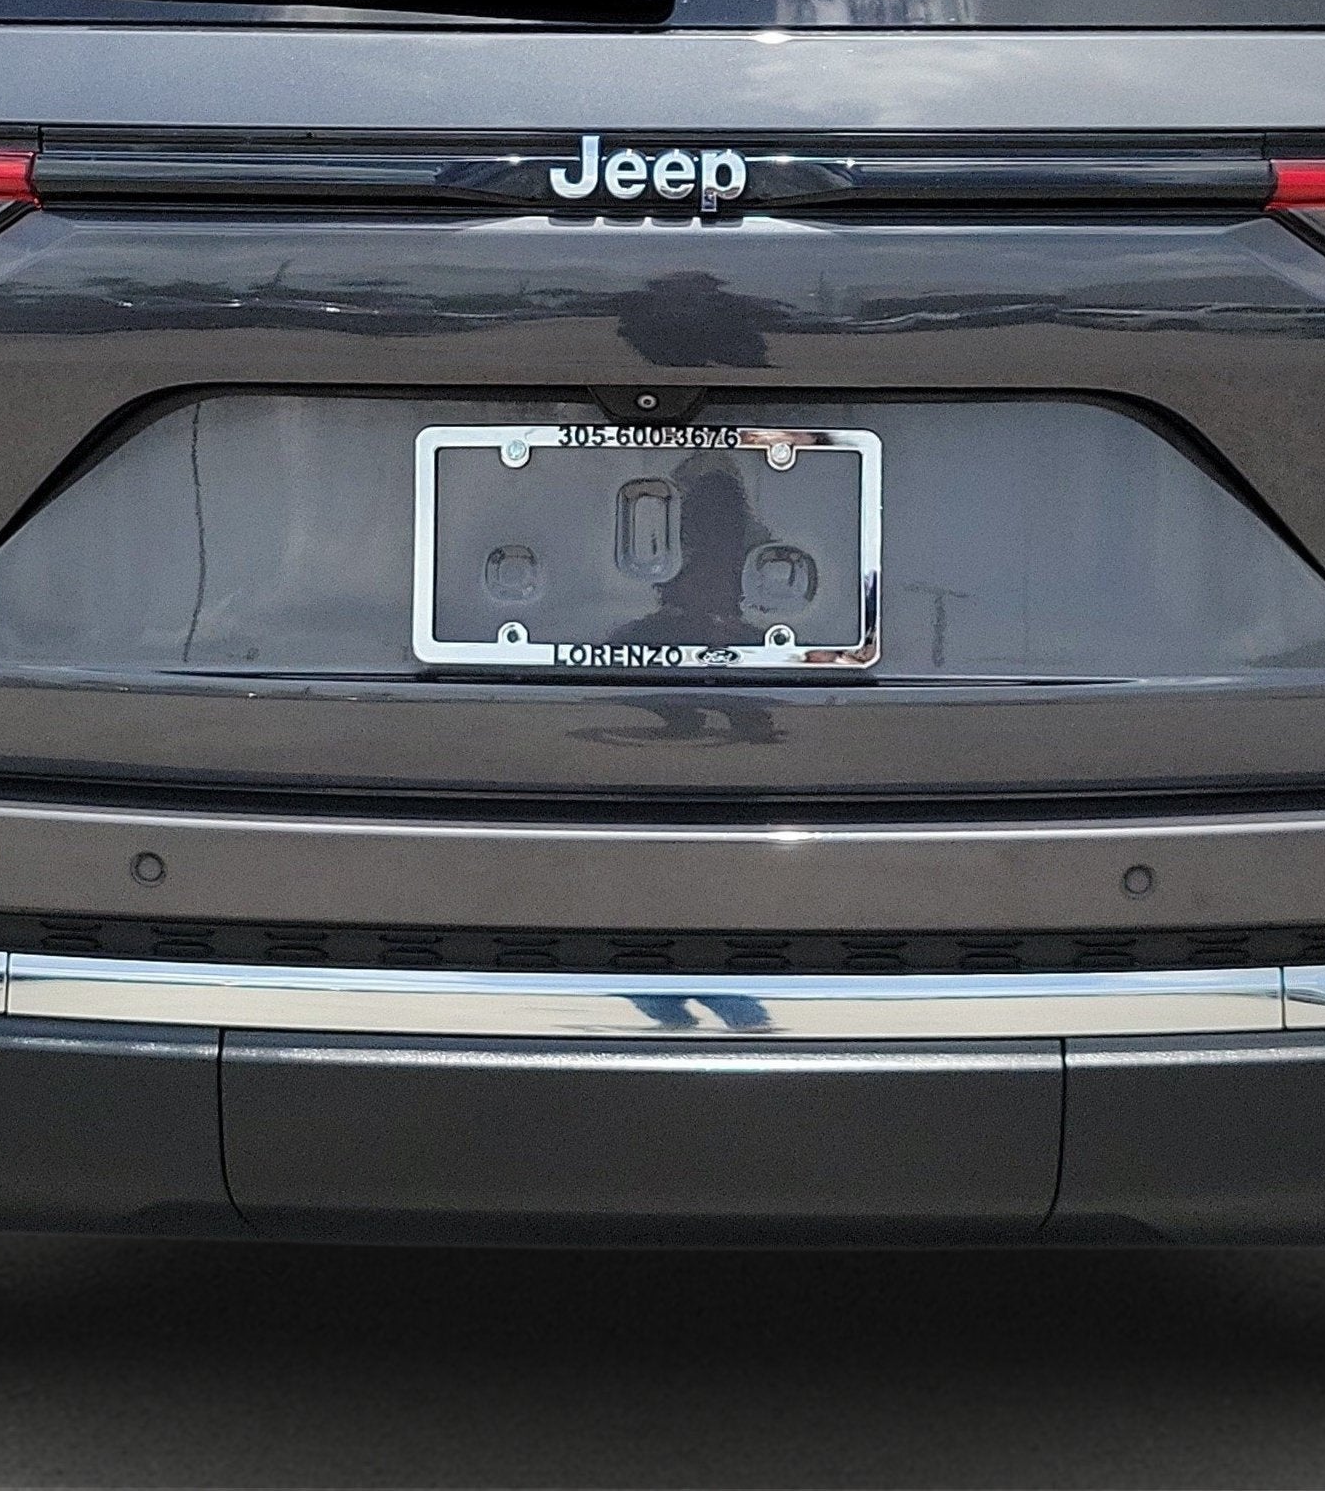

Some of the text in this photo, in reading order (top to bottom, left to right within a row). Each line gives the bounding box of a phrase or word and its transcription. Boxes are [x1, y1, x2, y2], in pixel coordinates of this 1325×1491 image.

[550, 135, 747, 212] Jeep
[558, 425, 740, 448] 305-600-3676
[554, 644, 684, 668] LORENZO
